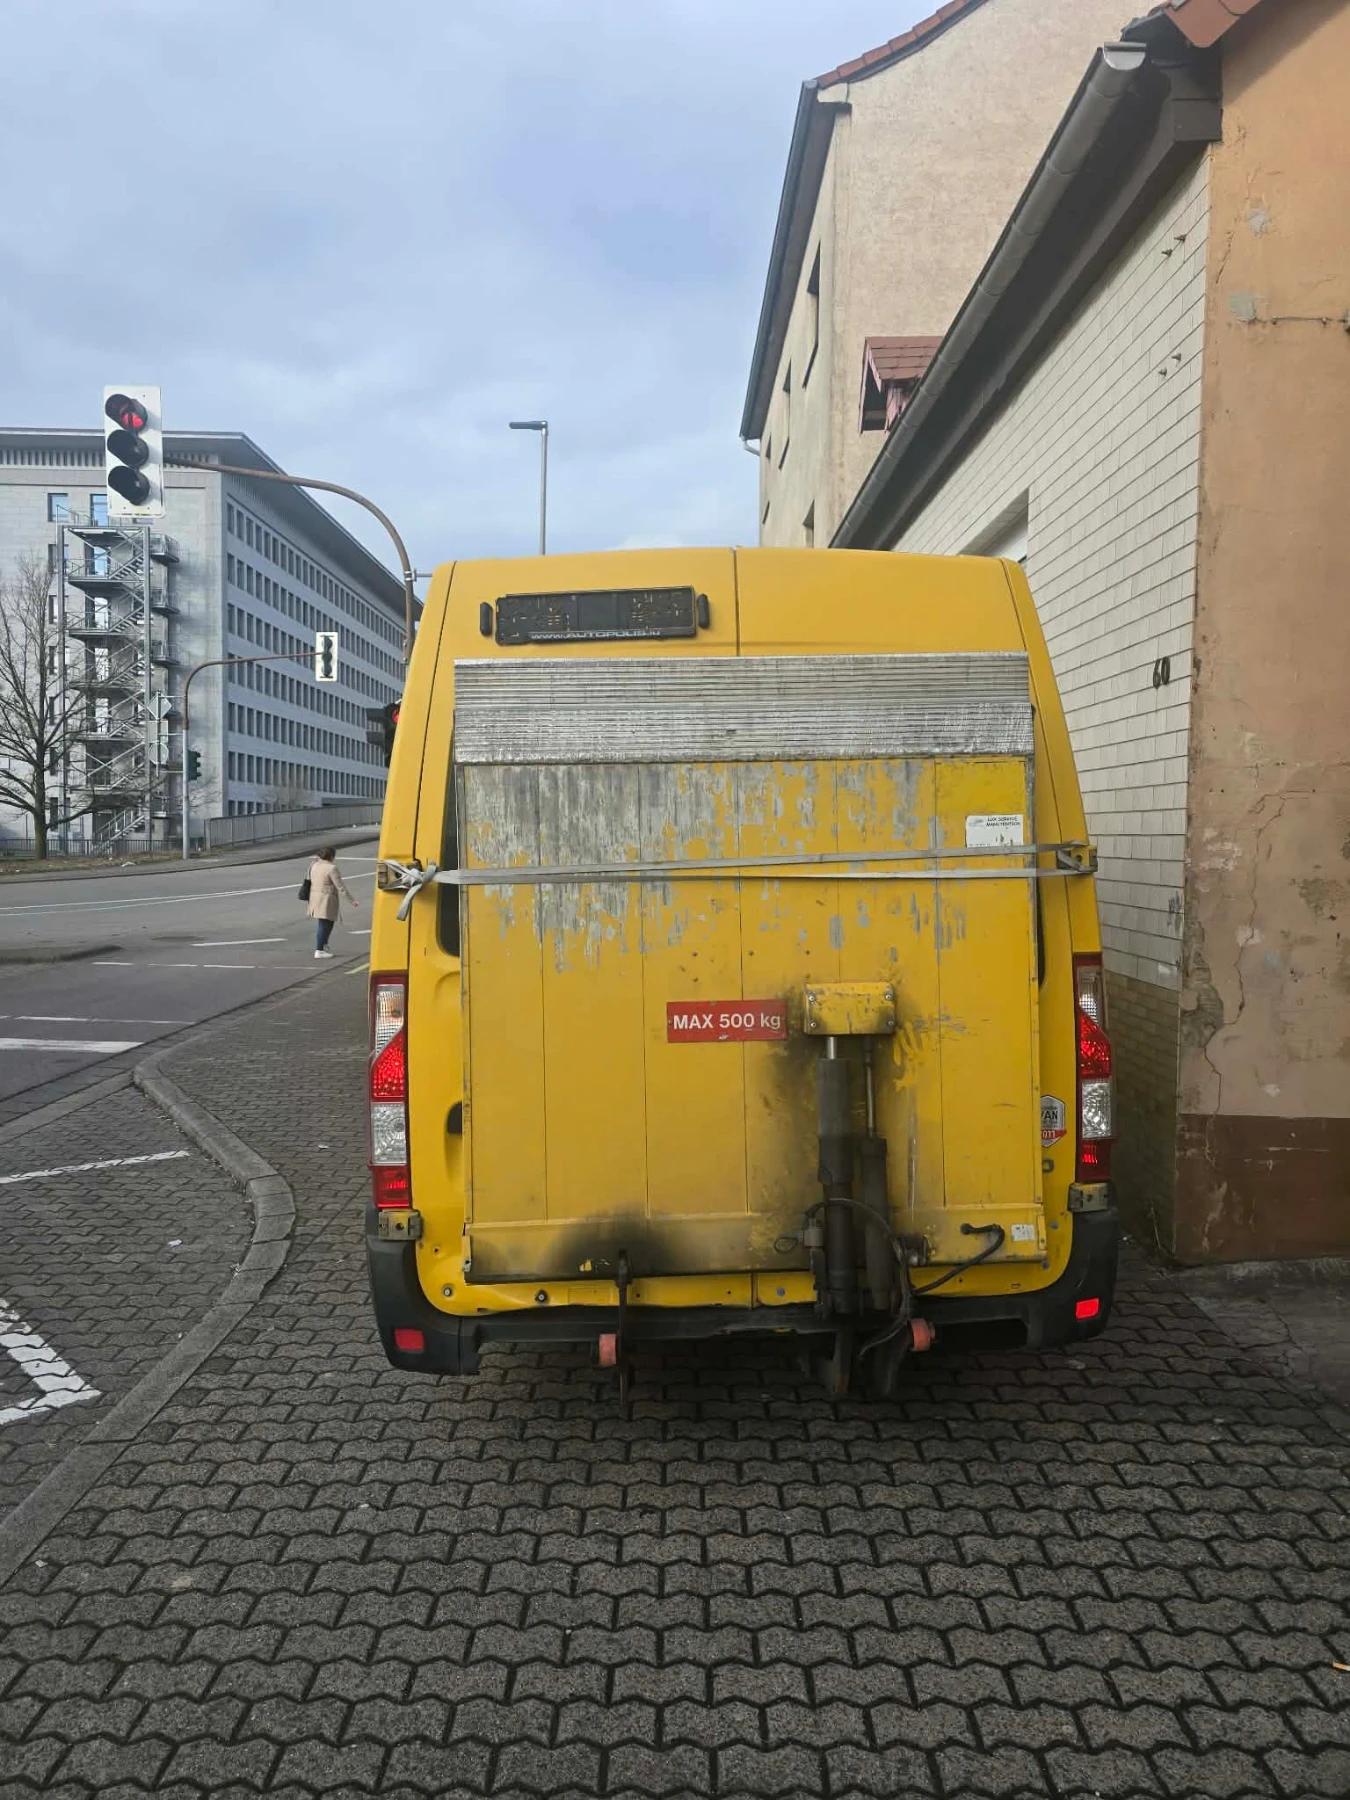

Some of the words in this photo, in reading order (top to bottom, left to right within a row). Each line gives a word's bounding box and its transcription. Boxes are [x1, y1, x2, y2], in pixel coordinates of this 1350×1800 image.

[1153, 657, 1170, 689] 60
[673, 1014, 714, 1030] MAX
[719, 1013, 755, 1029] 500
[760, 1012, 781, 1031] kg
